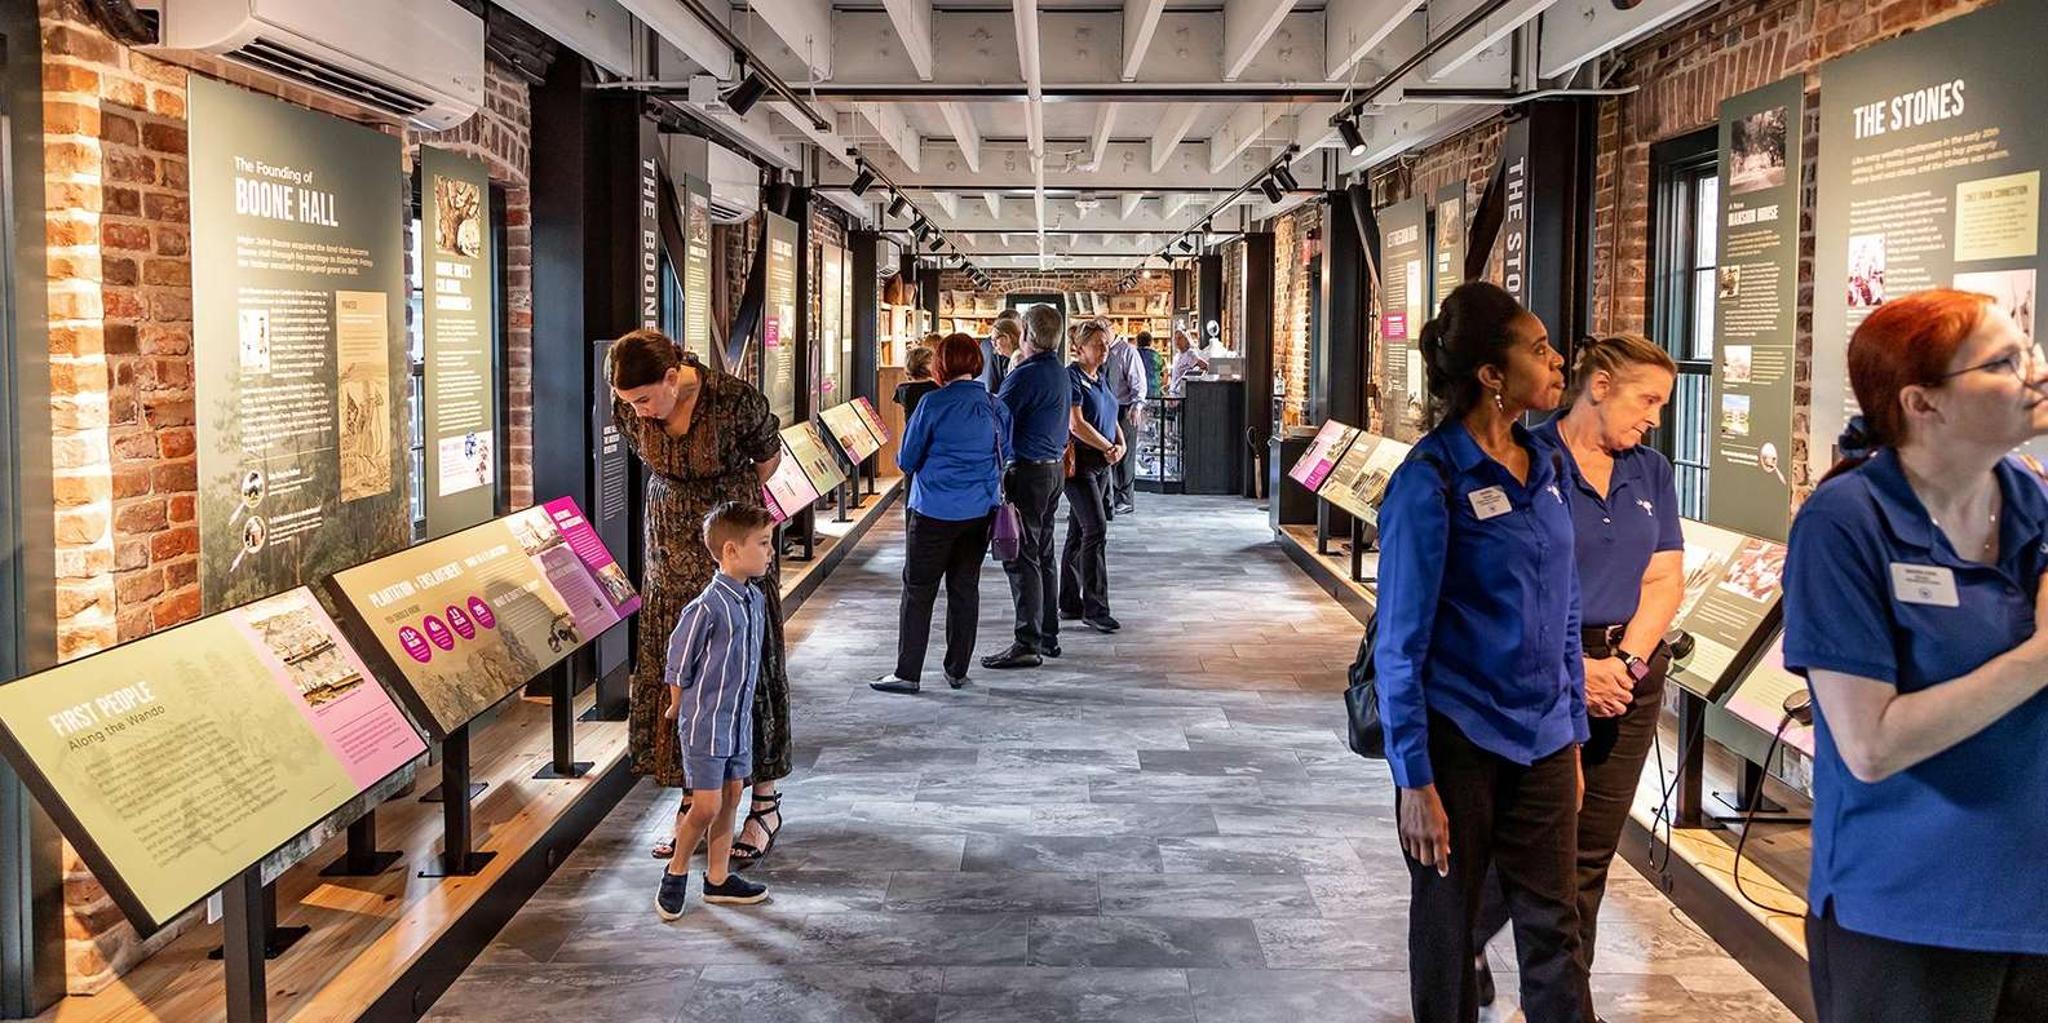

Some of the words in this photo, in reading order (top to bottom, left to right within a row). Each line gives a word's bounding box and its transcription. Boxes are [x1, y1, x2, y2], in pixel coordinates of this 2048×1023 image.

[1853, 100, 1887, 140] THE
[1890, 78, 1965, 131] STONES
[233, 155, 254, 173] The
[256, 161, 301, 185] Founding
[303, 170, 313, 183] of
[643, 158, 656, 219] THE
[1508, 156, 1524, 223] THE
[235, 176, 295, 221] BOONE
[299, 188, 339, 227] HALL
[643, 229, 656, 331] BOONE
[1506, 231, 1522, 304] STO
[48, 704, 98, 738] FIRST
[98, 681, 156, 716] PEOPLE
[69, 729, 105, 752] Along
[105, 717, 126, 736] the
[126, 704, 166, 727] Wando
